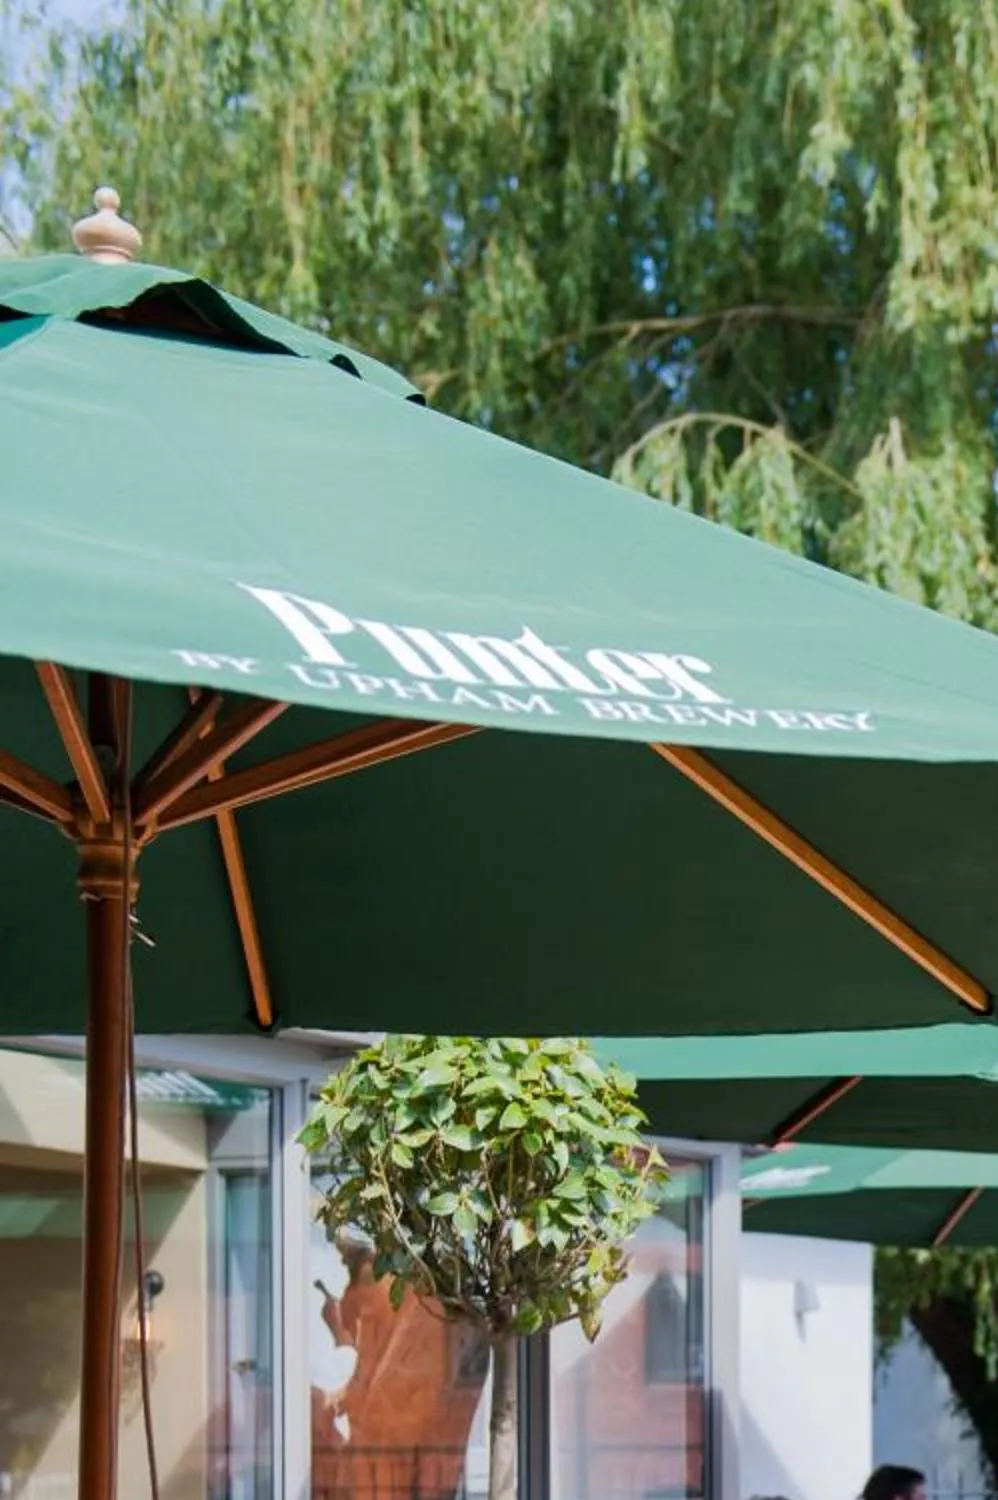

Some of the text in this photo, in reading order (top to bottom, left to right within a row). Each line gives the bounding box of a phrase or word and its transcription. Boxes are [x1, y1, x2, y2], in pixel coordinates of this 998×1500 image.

[172, 648, 876, 732] BY UPHAM BREWERY
[232, 581, 732, 704] Punter
